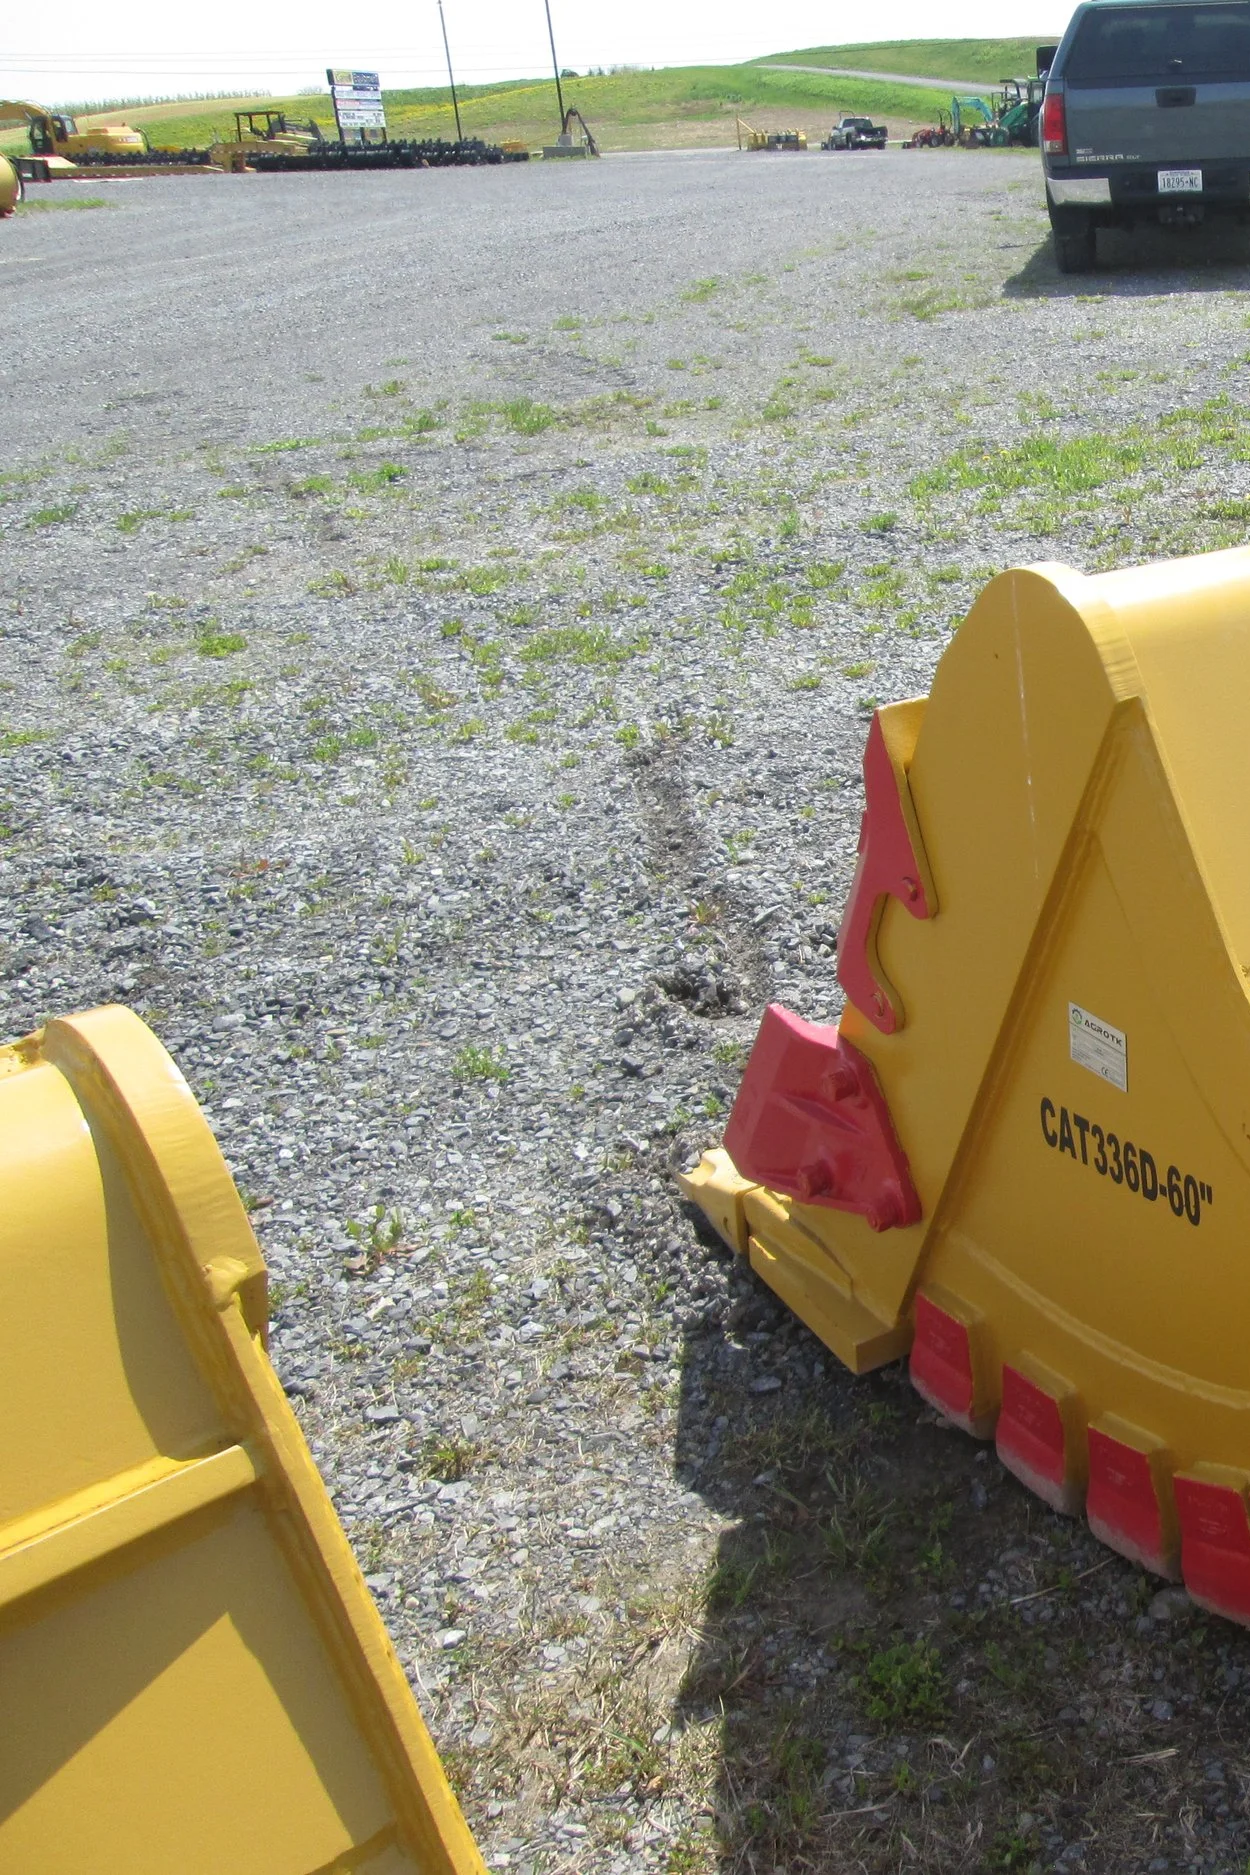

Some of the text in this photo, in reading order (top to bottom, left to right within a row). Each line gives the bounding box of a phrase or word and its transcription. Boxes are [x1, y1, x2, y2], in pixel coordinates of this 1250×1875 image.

[1076, 153, 1124, 163] SIERRA
[1084, 1019, 1122, 1047] AGROTK
[1040, 1096, 1213, 1227] CAT336D-60"
